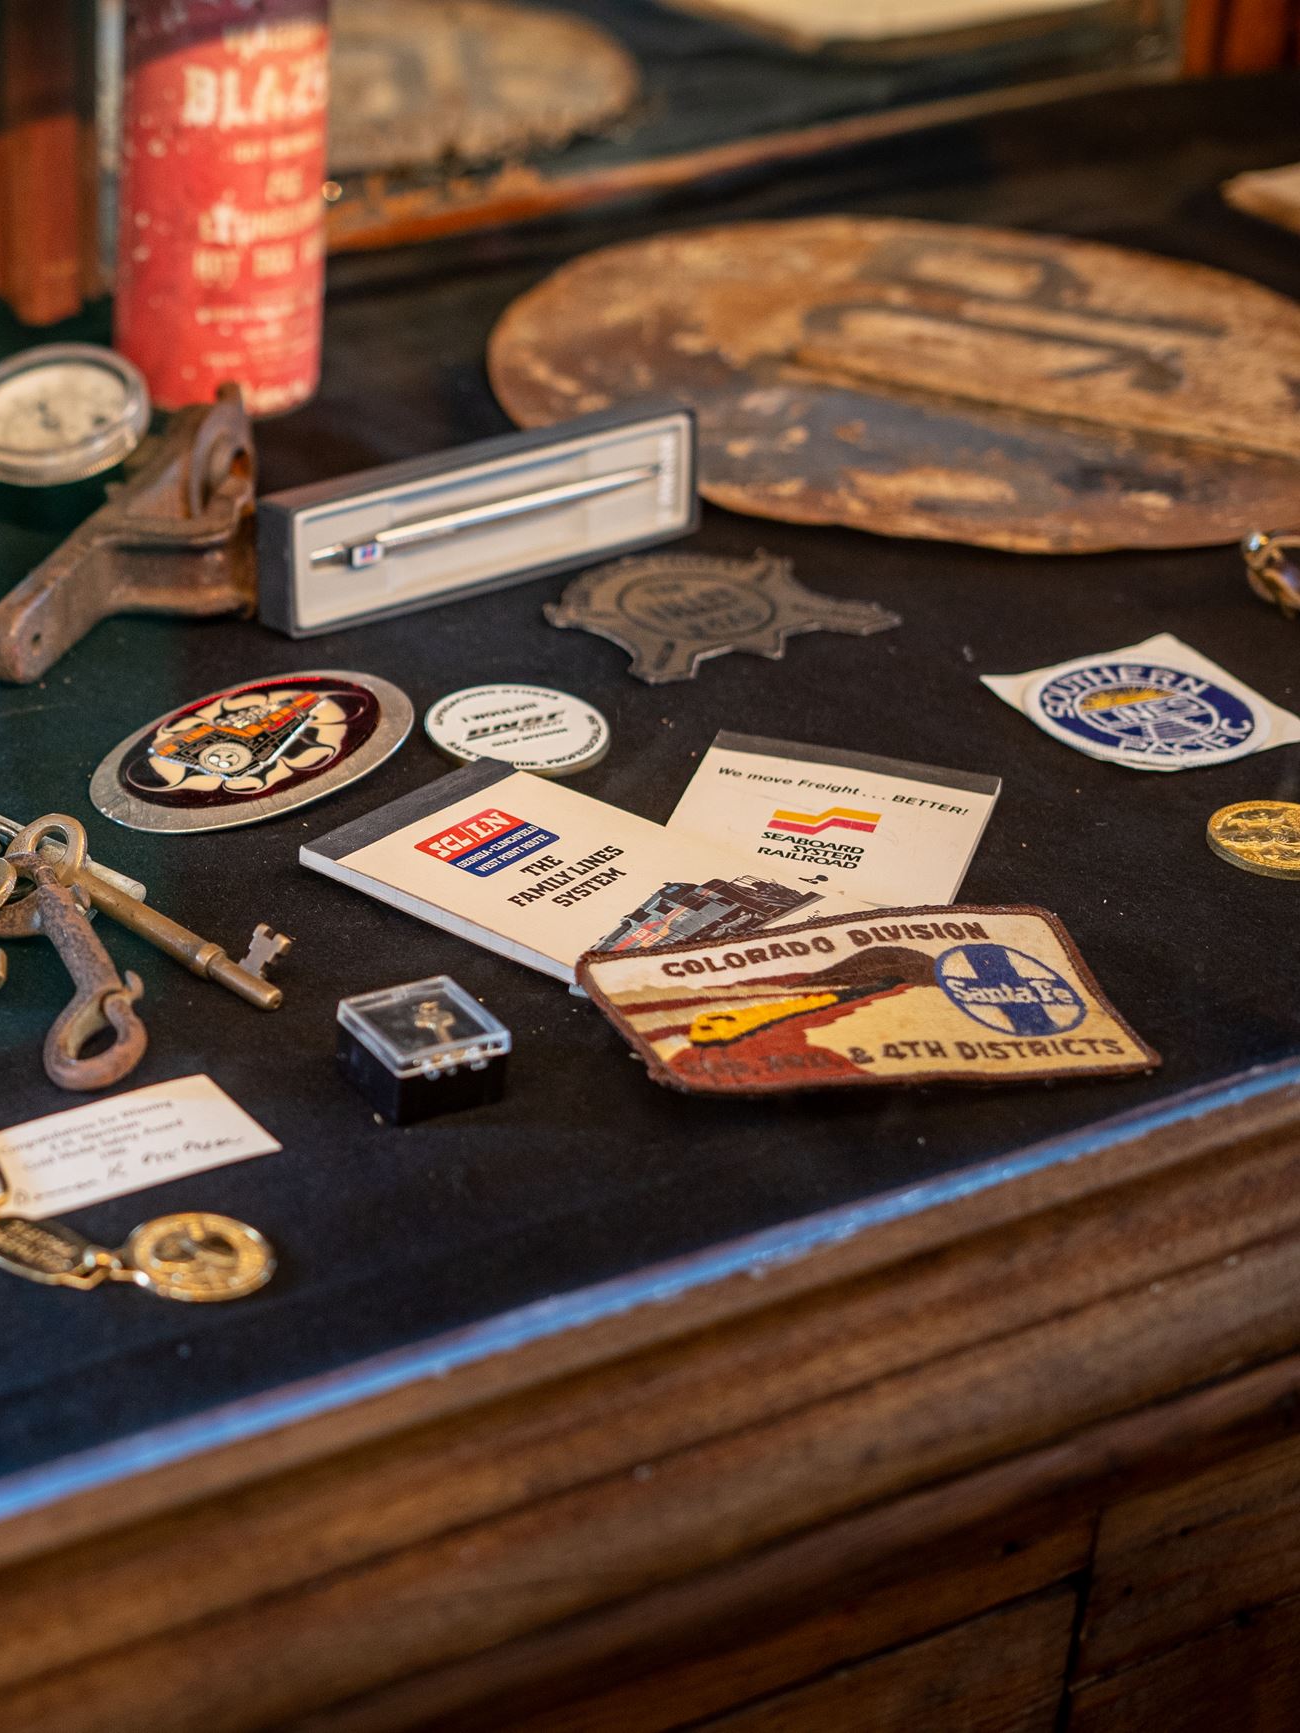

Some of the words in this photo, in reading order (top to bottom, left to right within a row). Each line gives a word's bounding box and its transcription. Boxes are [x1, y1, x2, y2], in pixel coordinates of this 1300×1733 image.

[1043, 665, 1211, 720] SOUTHERN
[1119, 717, 1253, 756] PACIFIC
[718, 766, 743, 778] We
[747, 772, 793, 786] move
[797, 779, 861, 796] Freight
[892, 794, 969, 816] BETTER!
[475, 856, 503, 872] WEST
[499, 846, 525, 862] POINT
[520, 833, 551, 850] ROUTE
[757, 846, 859, 870] RAILROAD
[761, 831, 866, 856] SEABOARD
[792, 844, 863, 863] SYSTEM
[507, 870, 576, 907] FAMILY
[566, 845, 625, 876] LINES
[519, 854, 564, 877] THE
[551, 866, 628, 908] SYSTEM
[661, 936, 836, 978] COLORADO
[846, 921, 991, 948] DIVISION
[944, 978, 1033, 1005] Santa
[1028, 978, 1075, 1005] Fe
[849, 1046, 875, 1065] &
[882, 1040, 949, 1060] 4TH
[953, 1037, 1126, 1061] DISTRICTS
